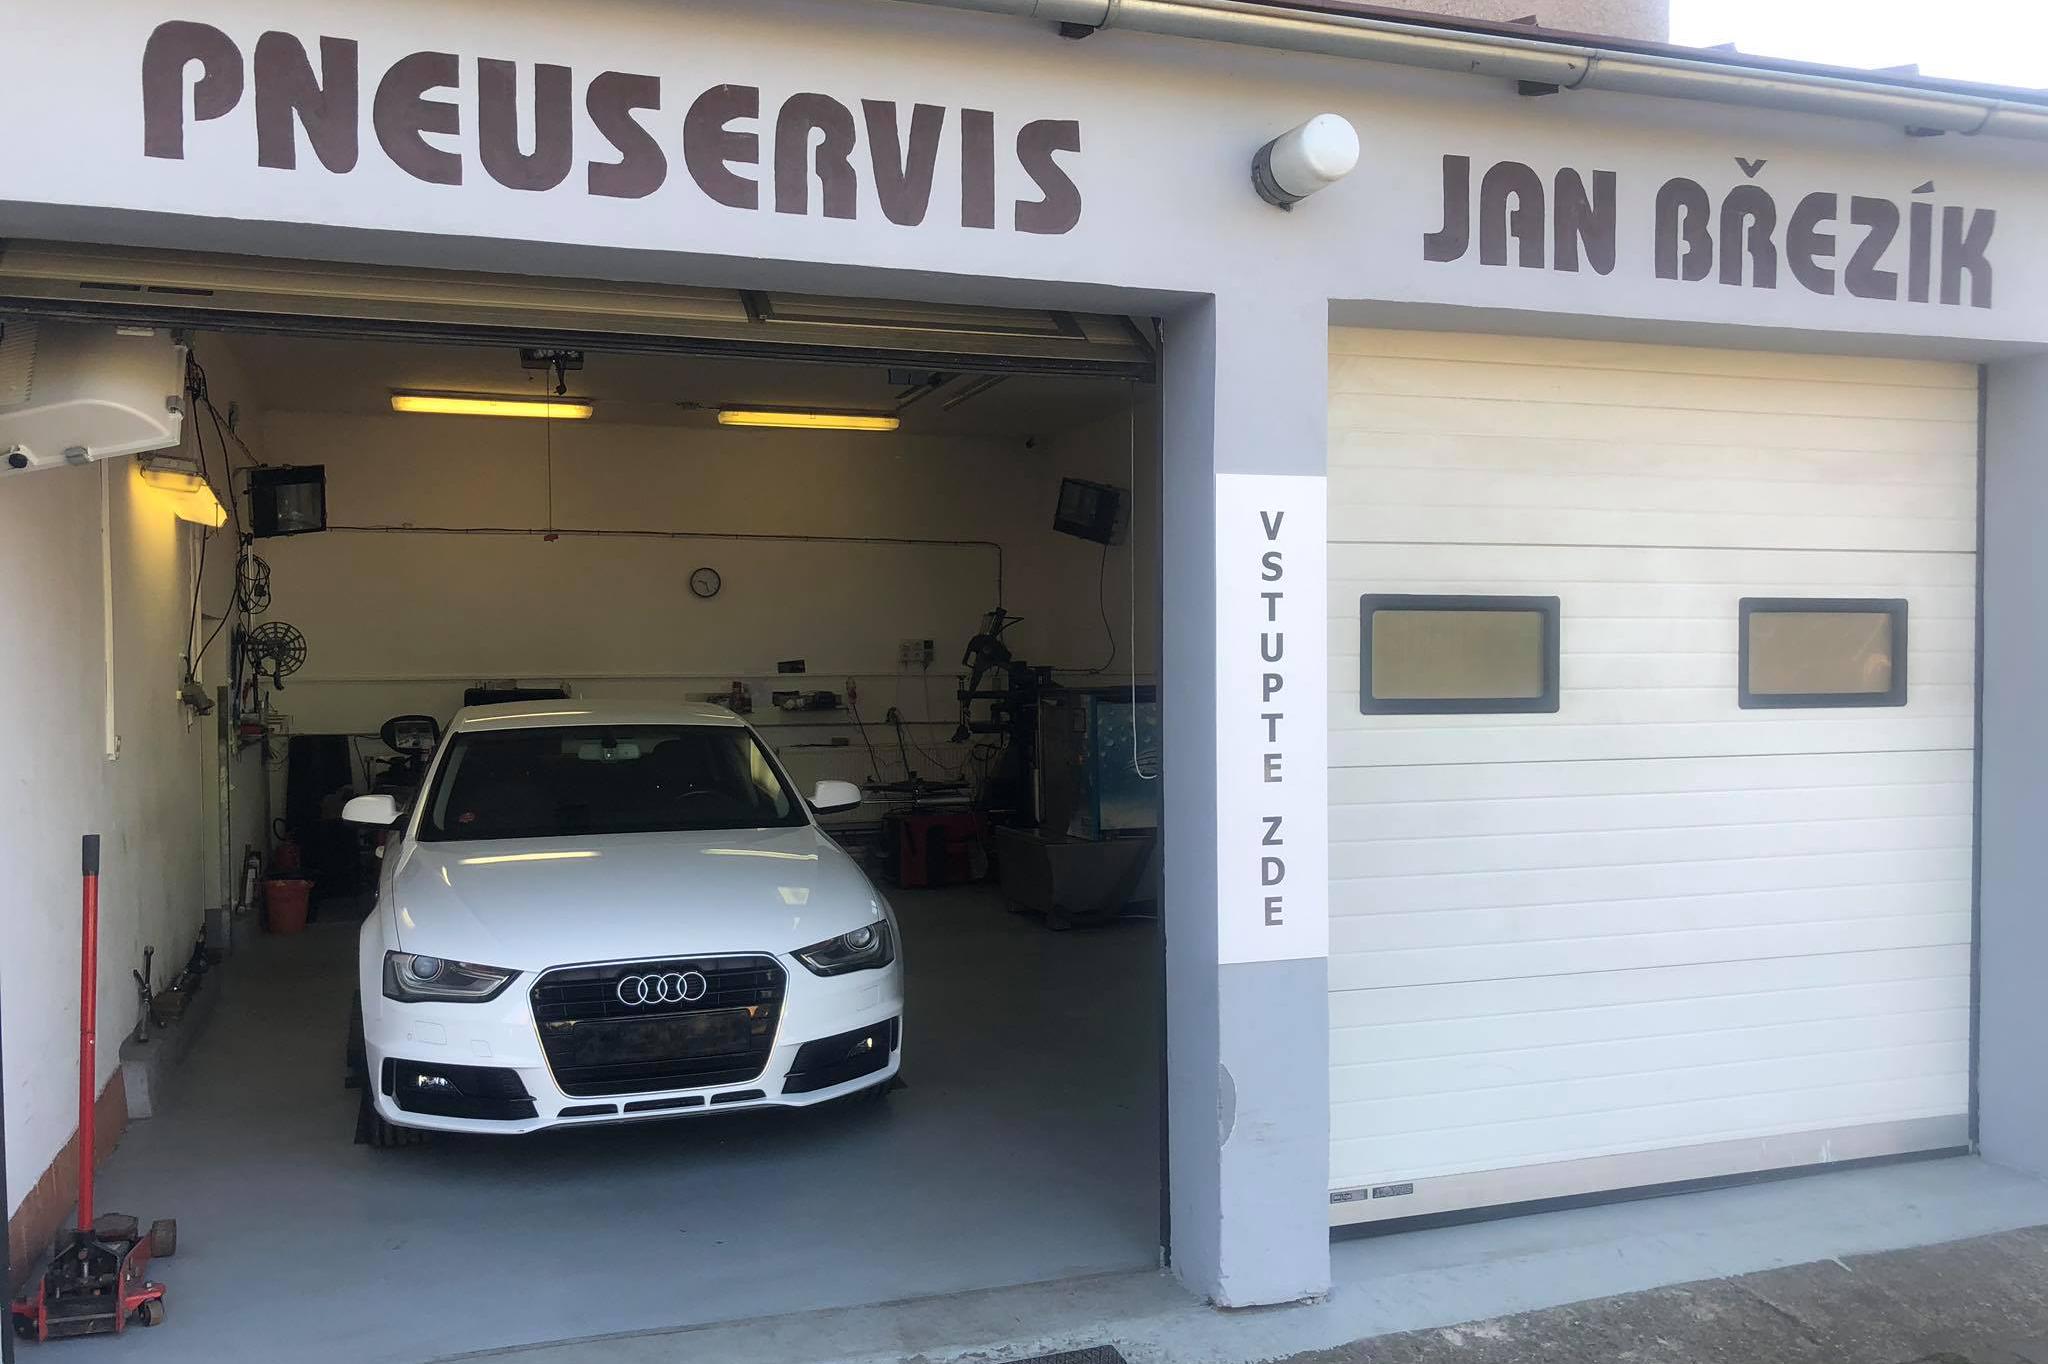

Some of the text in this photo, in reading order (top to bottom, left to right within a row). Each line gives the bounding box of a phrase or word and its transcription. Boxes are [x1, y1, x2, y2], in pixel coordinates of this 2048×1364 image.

[142, 20, 1082, 235] PNEUSERVIS
[1423, 154, 1996, 309] JAN BŘEZÍK
[1259, 511, 1286, 926] VSTUPTE ZDE
